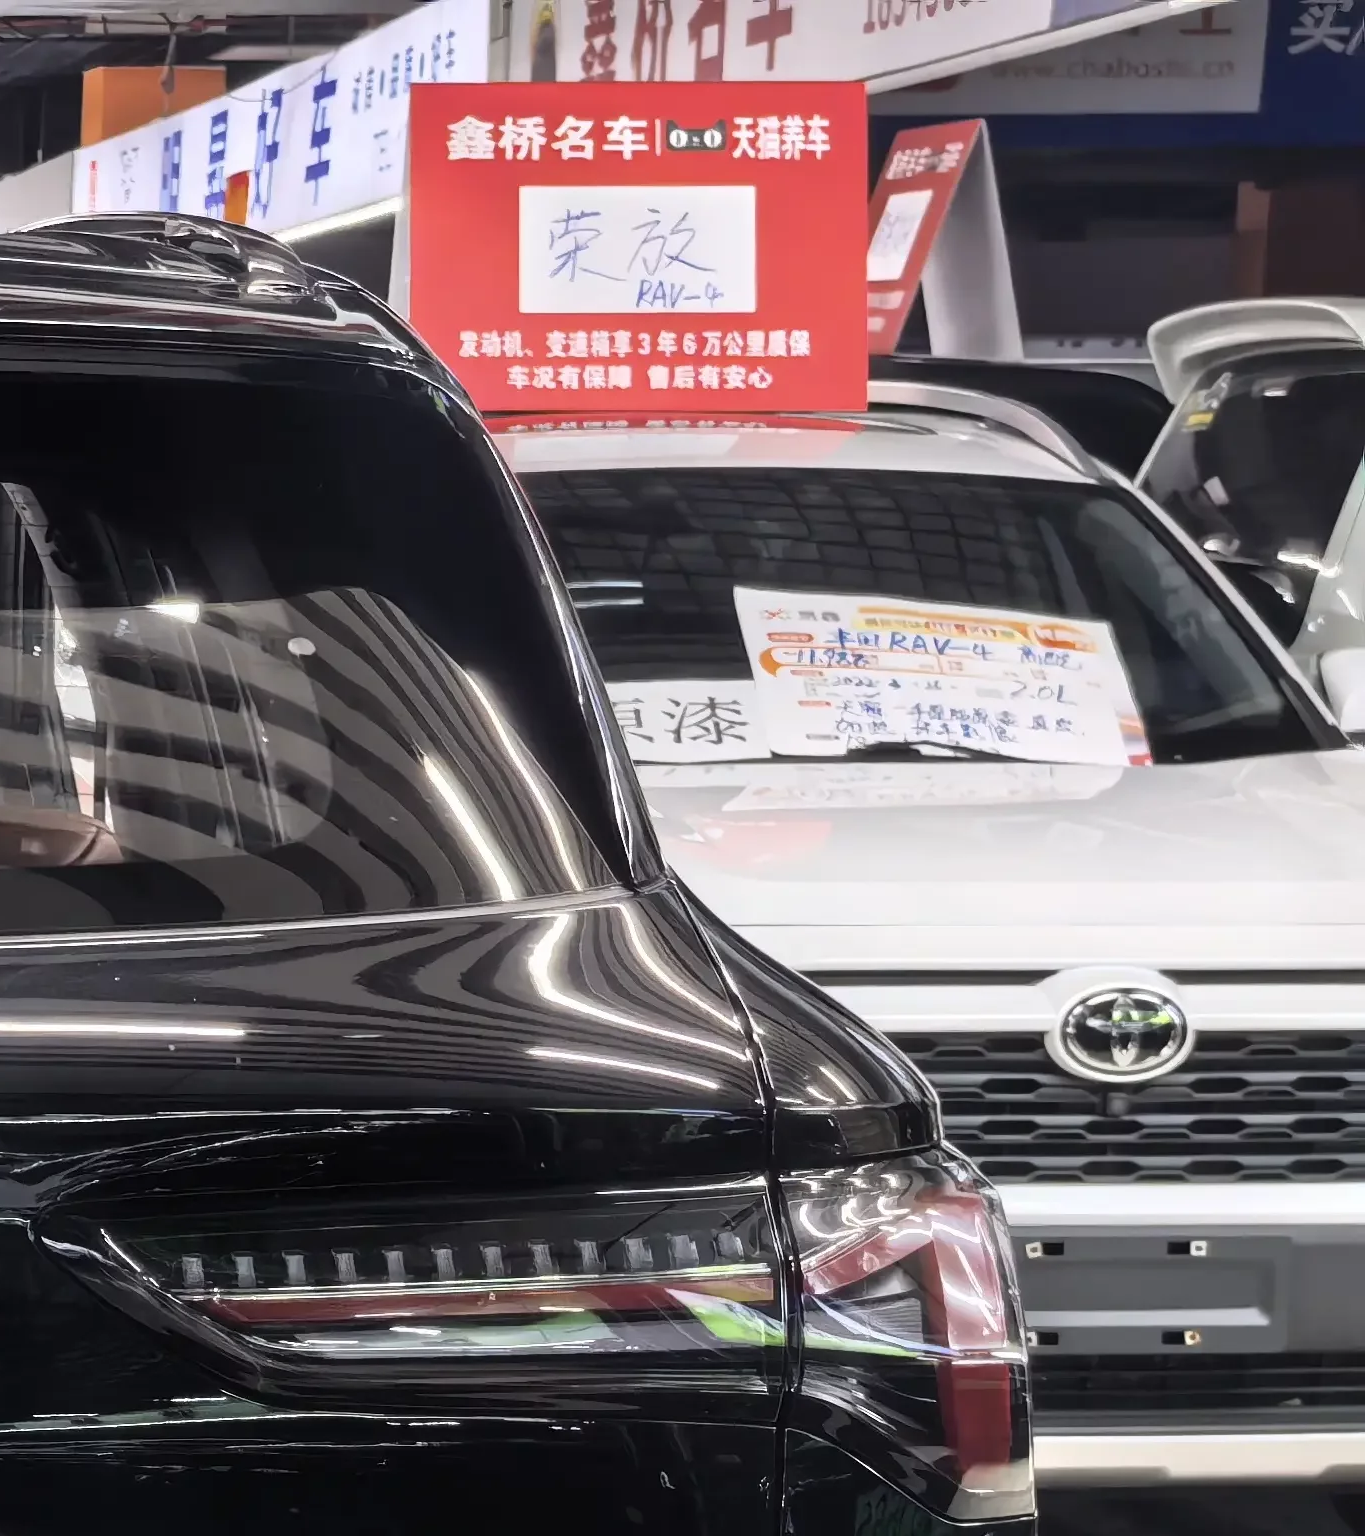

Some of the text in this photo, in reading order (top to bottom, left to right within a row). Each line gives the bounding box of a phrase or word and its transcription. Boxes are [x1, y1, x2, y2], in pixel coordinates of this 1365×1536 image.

[446, 115, 649, 161] 鑫桥名车
[731, 115, 831, 160] 天猫养车
[549, 208, 717, 284] 荣放
[506, 365, 774, 390] 车况有保障 售后有安心
